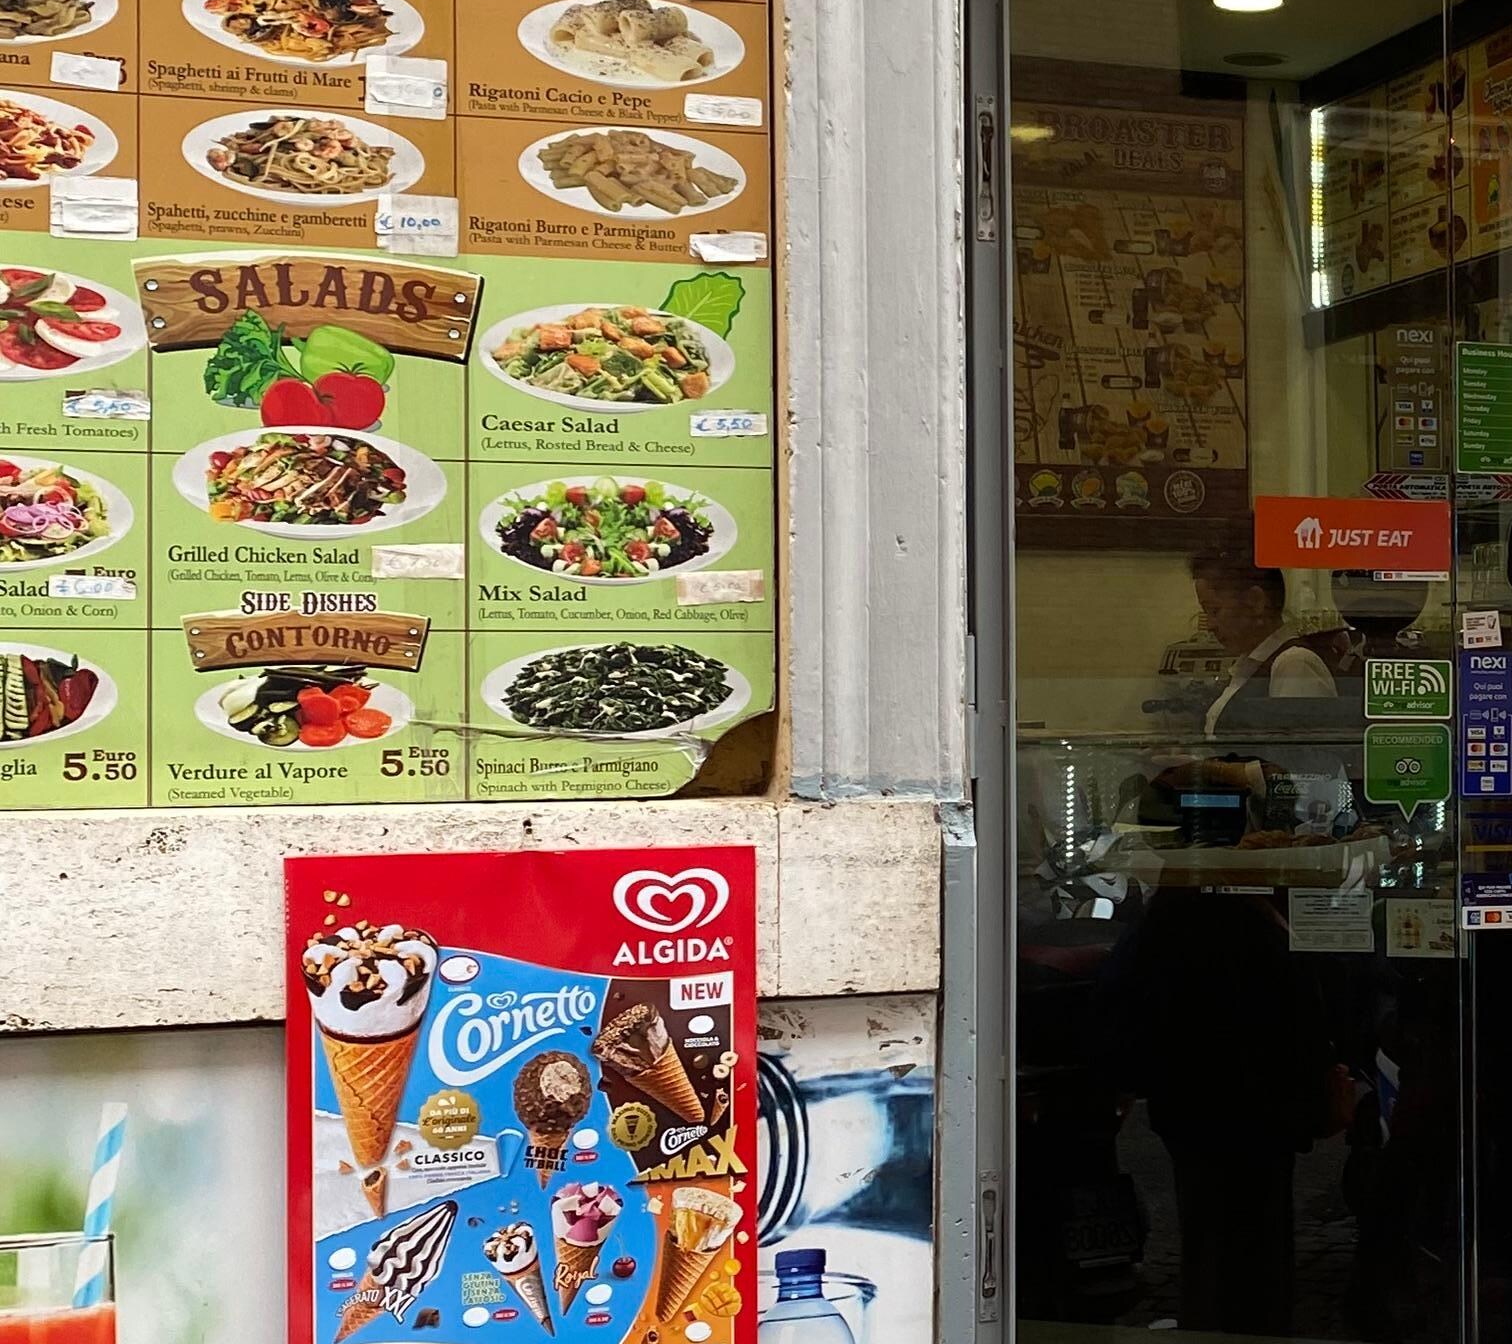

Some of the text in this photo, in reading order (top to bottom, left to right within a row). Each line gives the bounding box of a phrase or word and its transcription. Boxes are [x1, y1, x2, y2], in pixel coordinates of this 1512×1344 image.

[148, 60, 351, 88] Spaghetti ai Frutti di Mare
[469, 84, 651, 108] Rigatoni Cacio e Pepe
[148, 203, 366, 230] Spahetti, zucchine e gamberetti
[469, 217, 676, 242] Rigatoni Burro e Parmigiano
[189, 264, 436, 322] SALADS
[1397, 328, 1434, 344] nexi
[16, 423, 139, 441] Fresh Tomatoes)
[481, 415, 619, 433] Caesar Salad
[1328, 528, 1413, 547] JUST EAT
[168, 546, 359, 565] Grilled Chicken Salad
[241, 592, 376, 613] SIDE DISHES
[478, 586, 587, 601] Mix Salad
[225, 624, 392, 658] CONTORNO
[1372, 662, 1415, 678] FREE
[1470, 655, 1506, 669] nexi
[1372, 680, 1415, 696] WI-FI
[1372, 735, 1444, 745] RECOMMENDED
[93, 750, 136, 762] Euro
[409, 746, 448, 759] Euro
[168, 763, 349, 784] Verdure al Vapore
[476, 759, 525, 778] Spinaci
[583, 758, 658, 775] Parmigiano
[168, 786, 294, 801] (Steamed Vegetable)
[612, 938, 730, 967] ALGIDA
[682, 982, 725, 1002] NEW
[428, 988, 596, 1086] Cornetto
[659, 1125, 708, 1155] Cornetto
[414, 1149, 485, 1166] CLASSICO
[525, 1145, 568, 1160] CHOC
[650, 1124, 748, 1181] MAX
[555, 1256, 598, 1291] Royal
[380, 1286, 417, 1323] XXL
